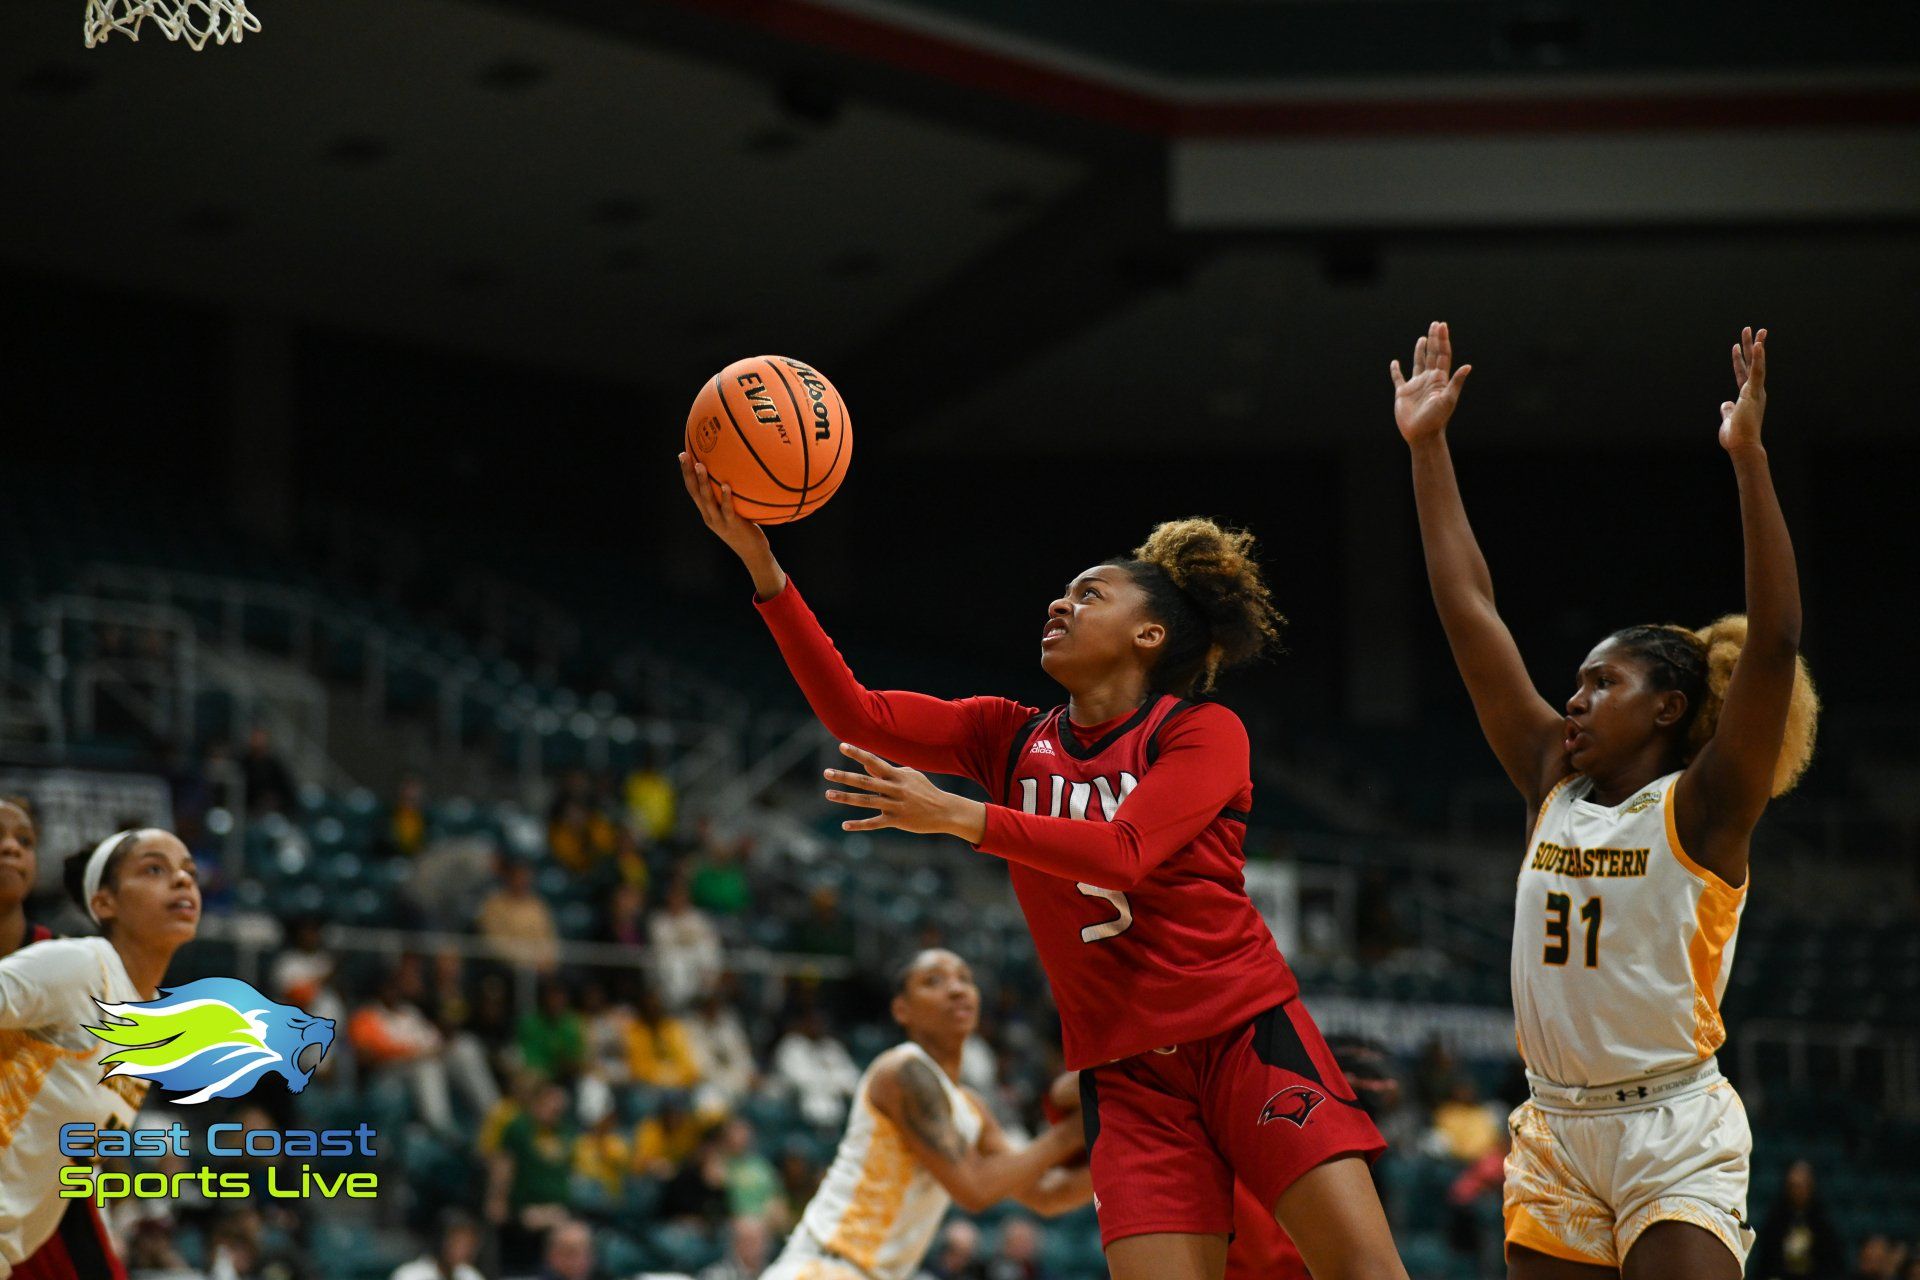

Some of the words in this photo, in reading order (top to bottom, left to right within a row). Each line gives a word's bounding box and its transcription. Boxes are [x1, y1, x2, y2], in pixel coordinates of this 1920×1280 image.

[736, 372, 782, 425] EVO
[776, 424, 791, 445] NXT
[1531, 841, 1650, 878] SOUHEASTERN
[1542, 891, 1603, 969] 31
